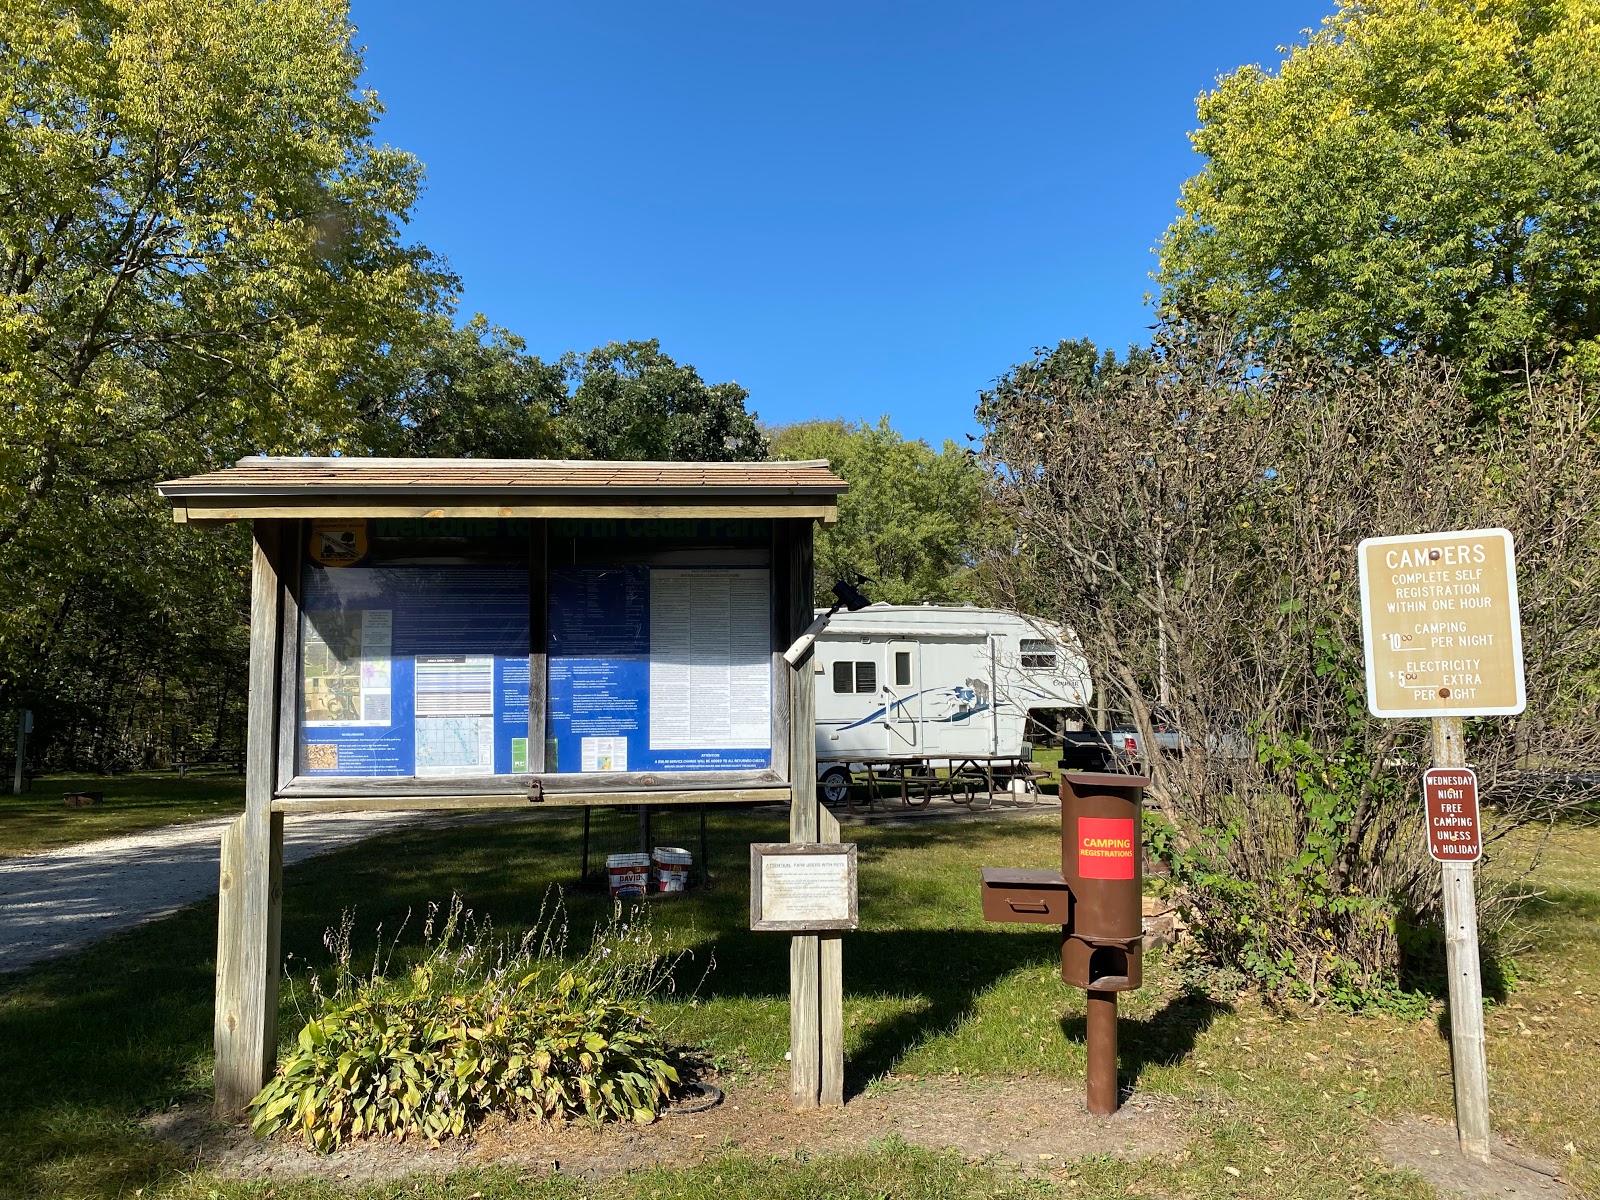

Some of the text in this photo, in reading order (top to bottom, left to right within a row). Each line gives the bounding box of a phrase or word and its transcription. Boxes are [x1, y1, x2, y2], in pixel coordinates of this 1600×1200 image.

[1386, 544, 1486, 569] CAMPERS
[1392, 569, 1483, 586] COMPLETE SELF
[1396, 584, 1480, 599] REGISTRATION
[1387, 597, 1492, 614] WITHIN ONE HOUR
[1415, 622, 1467, 635] CAMPING
[1431, 636, 1453, 648] PER
[1459, 634, 1494, 647] NIGHT
[1406, 659, 1481, 673] ELECTRICITY
[1443, 674, 1482, 686] EXTRA
[1414, 688, 1476, 700] PER IGHT
[1427, 776, 1473, 786] WEDNESDAY
[1438, 790, 1463, 799] NIGHT
[1441, 803, 1463, 813] FREE
[1434, 817, 1473, 827] CAMPING
[1437, 831, 1471, 840] UNLESS
[1083, 837, 1131, 848] CAMPING
[1080, 849, 1133, 858] REGISTRATIONS
[1433, 844, 1478, 854] A HOLIDAY
[619, 874, 641, 882] DAVID
